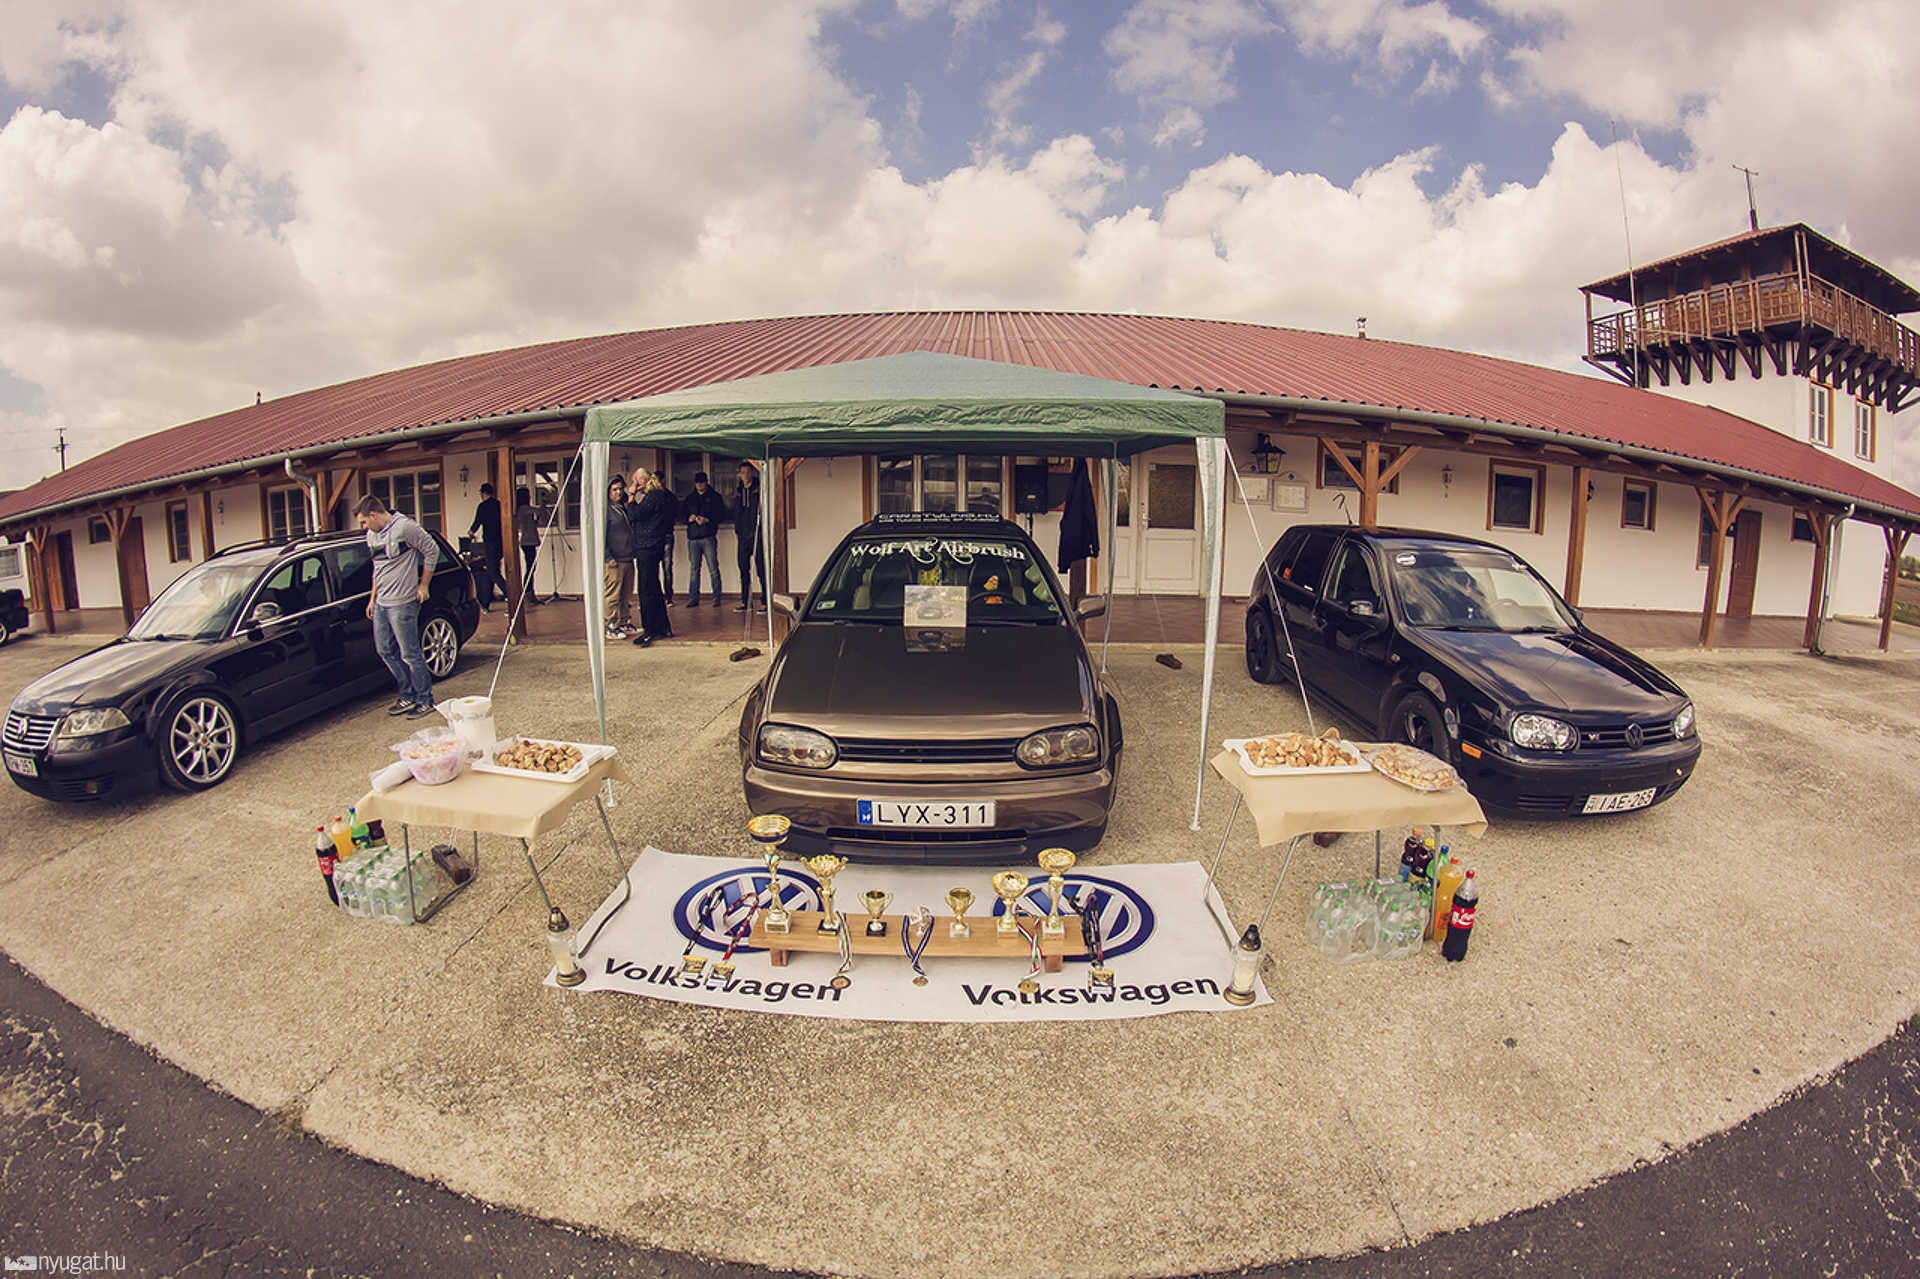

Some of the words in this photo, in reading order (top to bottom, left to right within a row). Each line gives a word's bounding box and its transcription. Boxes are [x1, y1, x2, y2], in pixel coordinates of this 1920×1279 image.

[850, 542, 899, 557] Wolf
[900, 536, 938, 564] Art
[937, 542, 1026, 565] Airbrush
[877, 803, 986, 824] LYX-311
